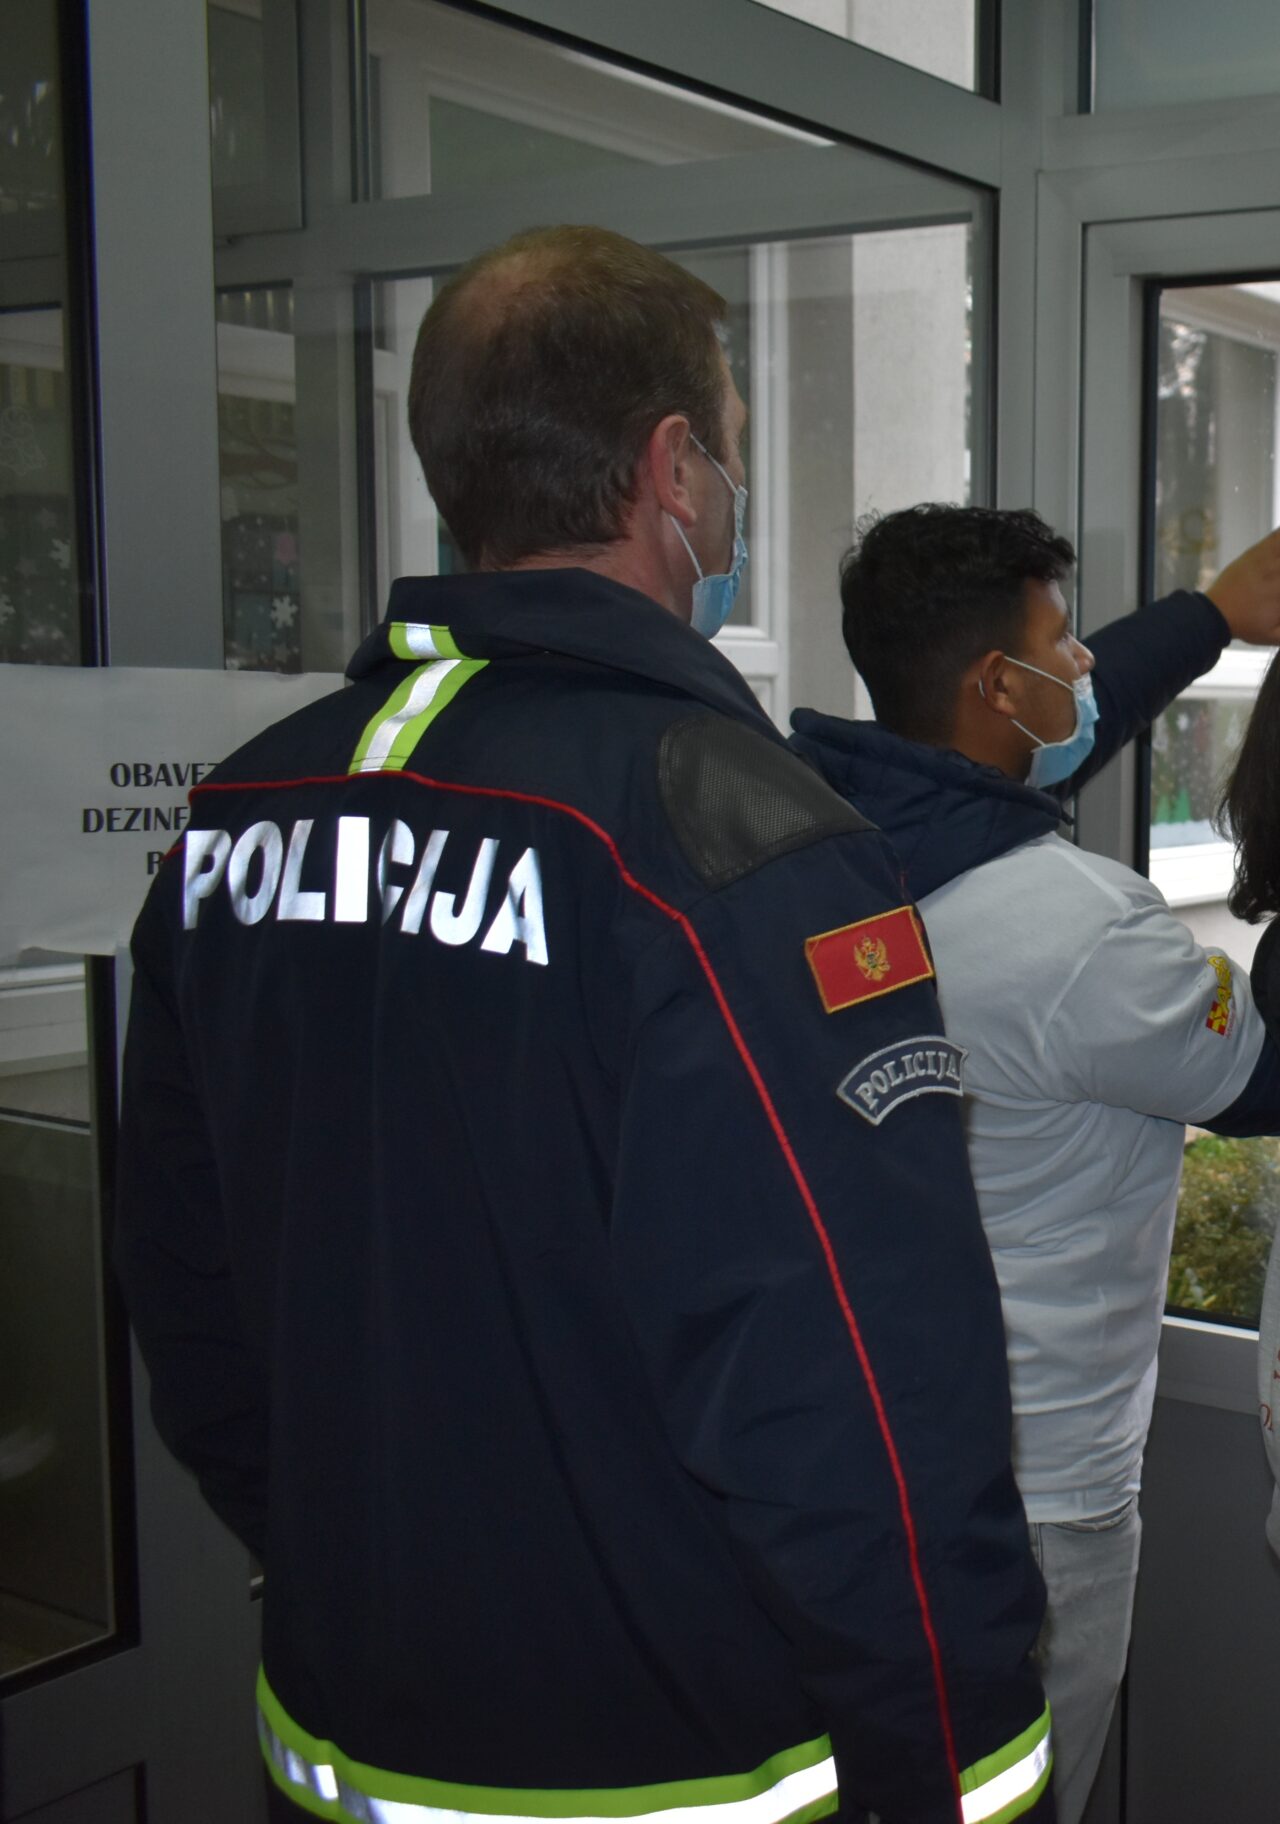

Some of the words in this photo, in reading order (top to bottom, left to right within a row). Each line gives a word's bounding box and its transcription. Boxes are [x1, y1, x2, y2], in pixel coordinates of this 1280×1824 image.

[109, 762, 222, 788] OBAVE
[183, 817, 548, 965] POLICIJA
[855, 1049, 961, 1110] POLICIJA
